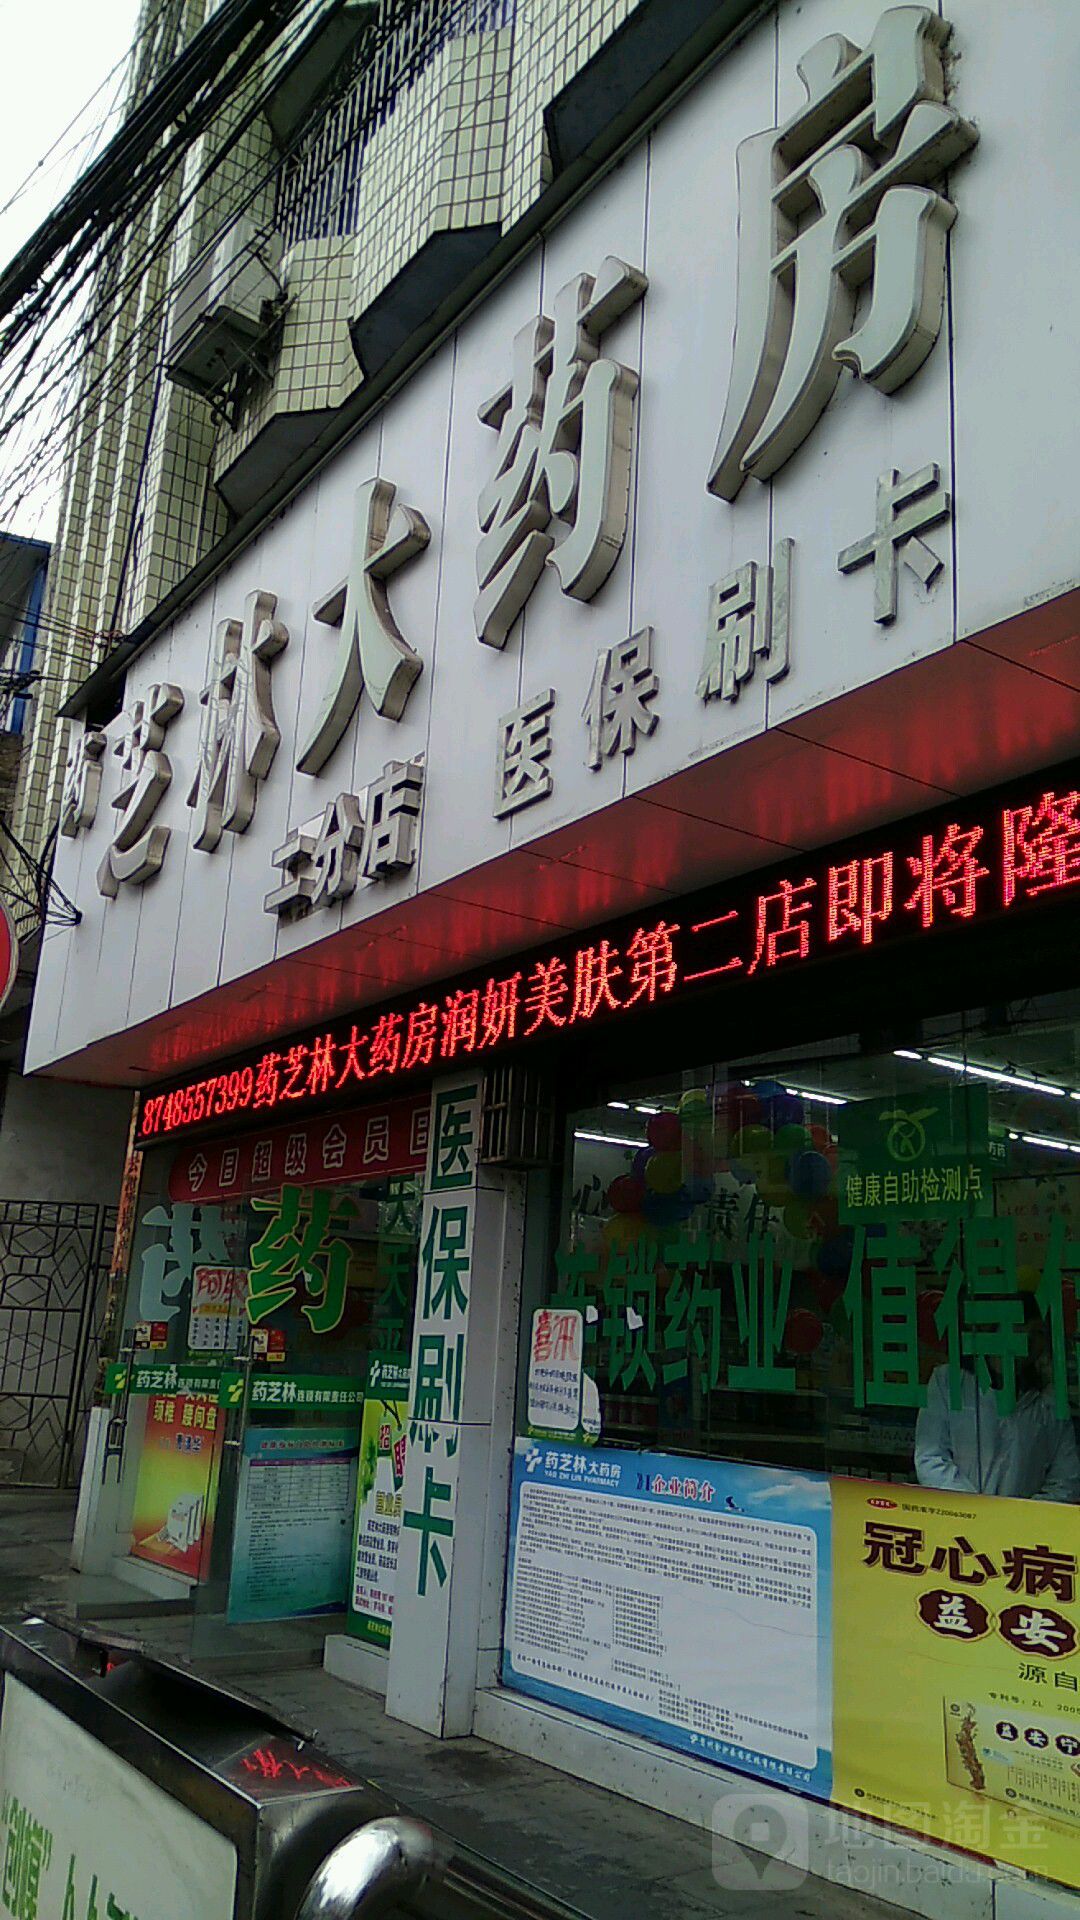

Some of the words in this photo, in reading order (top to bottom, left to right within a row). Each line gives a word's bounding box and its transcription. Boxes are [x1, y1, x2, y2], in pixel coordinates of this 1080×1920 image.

[60, 4, 979, 900] 药芝林大药房
[494, 462, 950, 820] 医保刷卡
[845, 1165, 984, 1210] 健康自助检测点
[246, 1184, 360, 1333] 药
[402, 1085, 480, 1597] 医保刷卡
[545, 1451, 622, 1480] 药芝林大药房
[651, 1473, 715, 1502] 企业简介
[862, 1521, 1076, 1603] 冠心病
[1018, 1662, 1079, 1693] 源自
